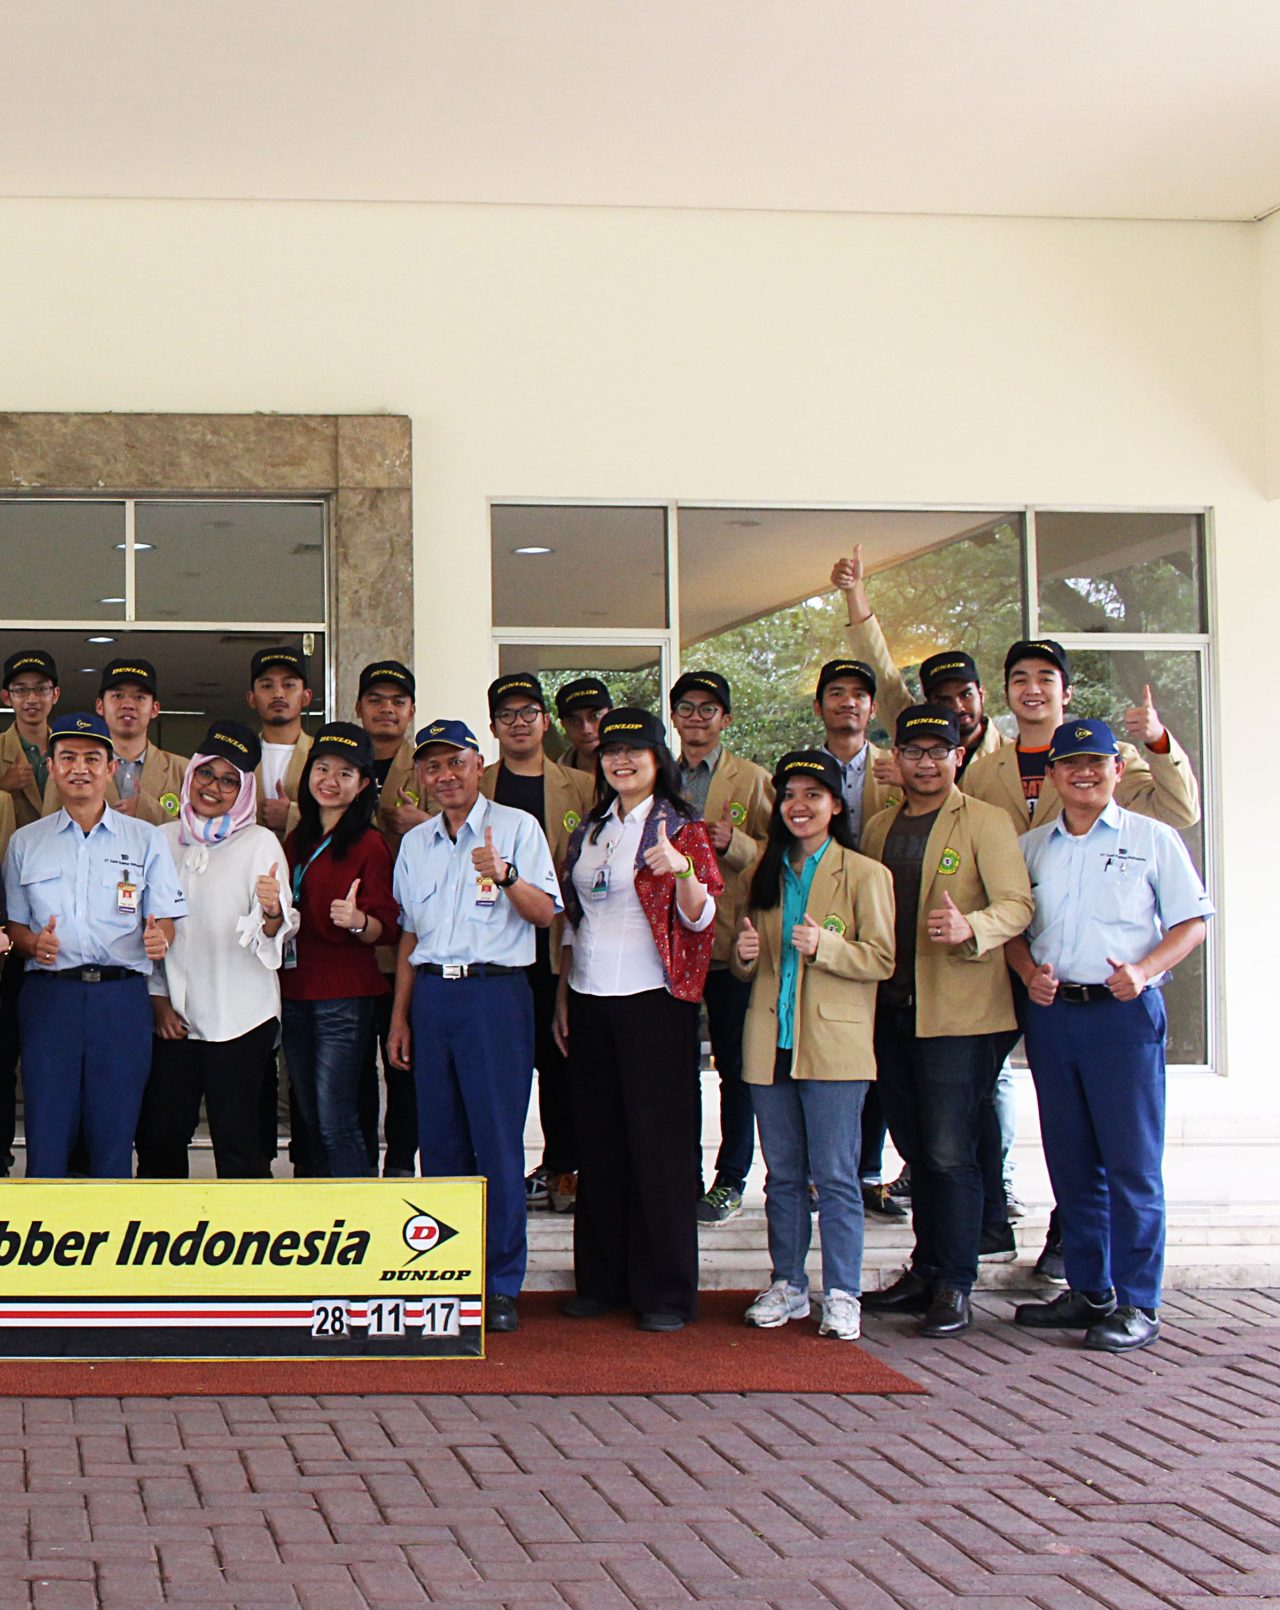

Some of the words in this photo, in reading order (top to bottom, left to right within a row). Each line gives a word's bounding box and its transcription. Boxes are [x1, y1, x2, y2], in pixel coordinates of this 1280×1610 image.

[112, 666, 149, 677] DUNLOP
[498, 682, 533, 694] DUNLOP
[906, 716, 950, 728] DUNLOP
[604, 723, 643, 734] DUNLOP
[214, 732, 250, 754] DUNLOP
[319, 735, 358, 747] DUNLOP
[784, 761, 825, 772] DUNLOP
[115, 1219, 371, 1267] Indonesia
[378, 1270, 472, 1281] DUNLOP
[315, 1306, 344, 1335] 28
[371, 1303, 401, 1332] 11
[426, 1303, 455, 1332] 17
